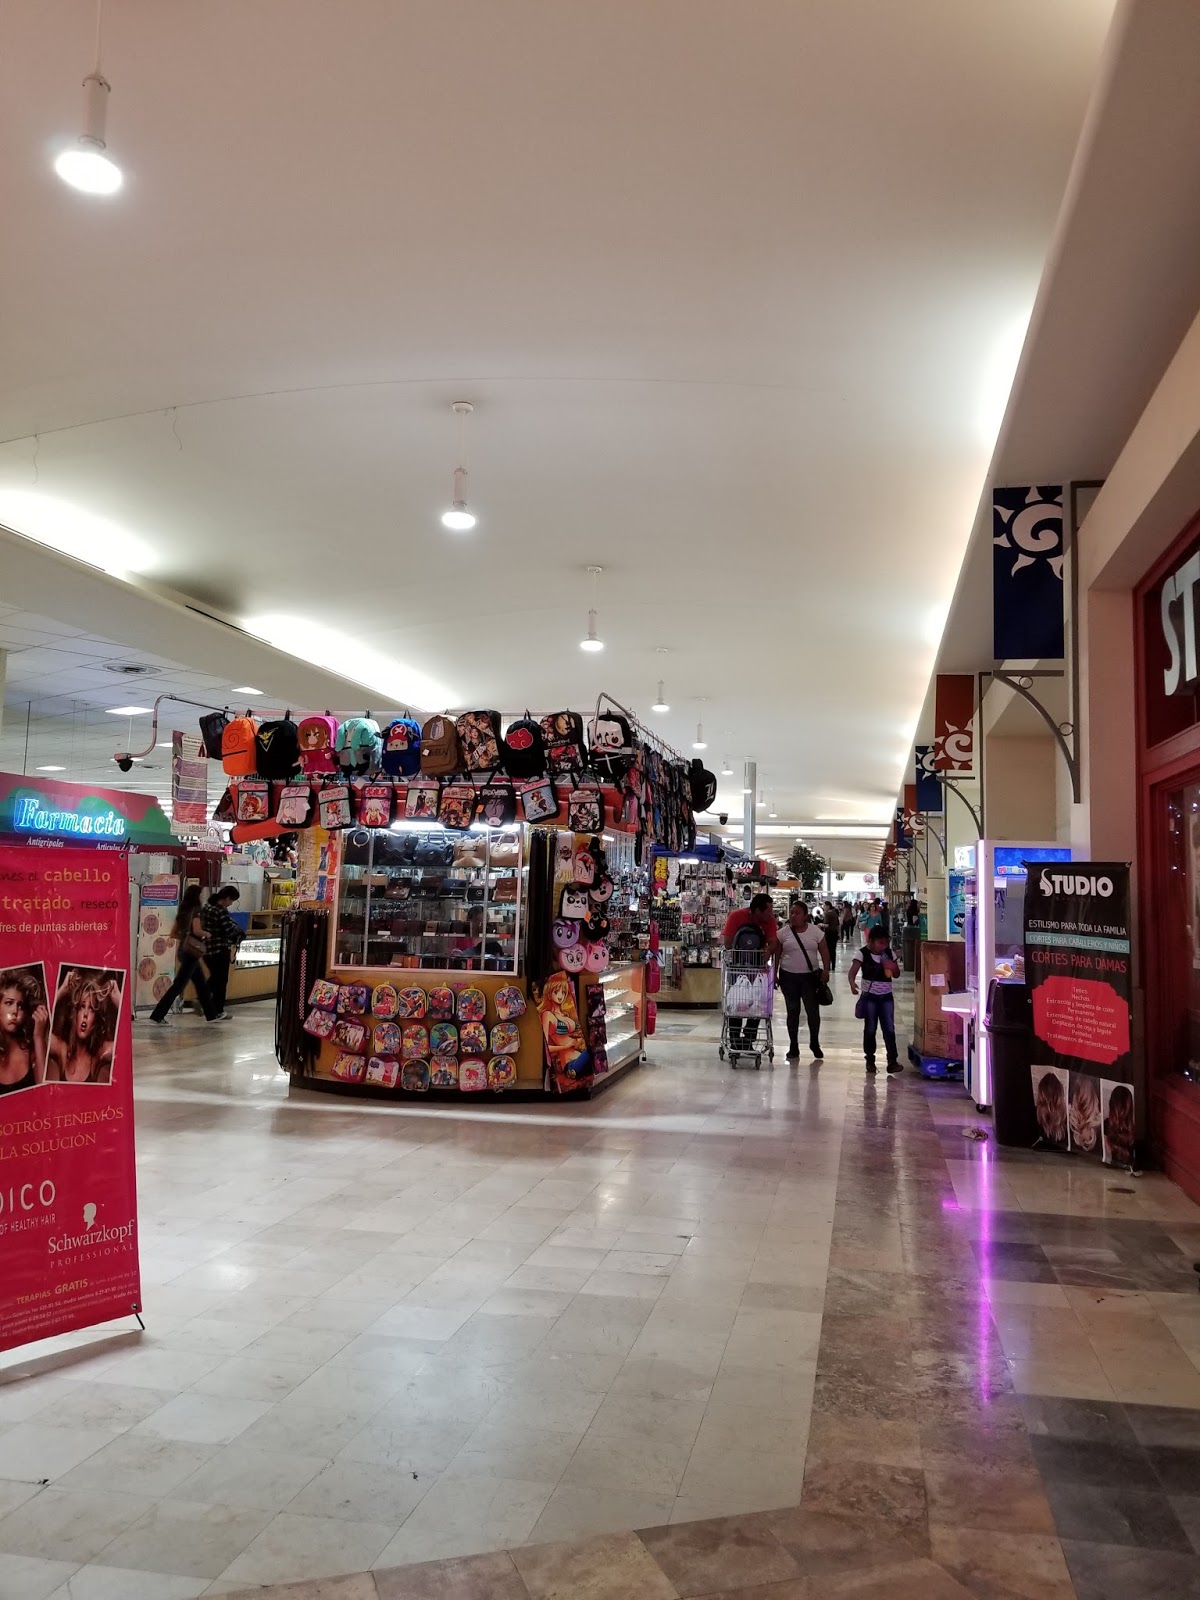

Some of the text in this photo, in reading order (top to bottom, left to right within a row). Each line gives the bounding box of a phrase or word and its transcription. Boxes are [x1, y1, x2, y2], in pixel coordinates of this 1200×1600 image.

[18, 798, 125, 836] Farmacia
[44, 868, 111, 882] cabello
[1039, 868, 1114, 898] STUDIO
[80, 899, 118, 909] reseco
[19, 921, 32, 932] de
[34, 921, 66, 934] puntas
[1028, 920, 1126, 936] ESTILISMO PARA TODA LA FAMILIA
[1030, 935, 1052, 944] CORTES
[1052, 936, 1068, 944] PARA
[1068, 937, 1104, 948] CABALLEROS
[1108, 940, 1126, 951] NIÑOS
[1032, 951, 1126, 973] CORTES PARA DAMAS
[54, 1106, 124, 1128] TENEMOS
[0, 1132, 97, 1160] LA SOLUCIÓN
[10, 1216, 39, 1233] HEALTHY
[40, 1213, 56, 1226] HAIR
[48, 1219, 135, 1254] Schwarzkopf
[50, 1243, 134, 1269] PROFESSIONAL
[16, 1290, 51, 1305] TERAPIAS
[54, 1278, 88, 1294] GRATIS
